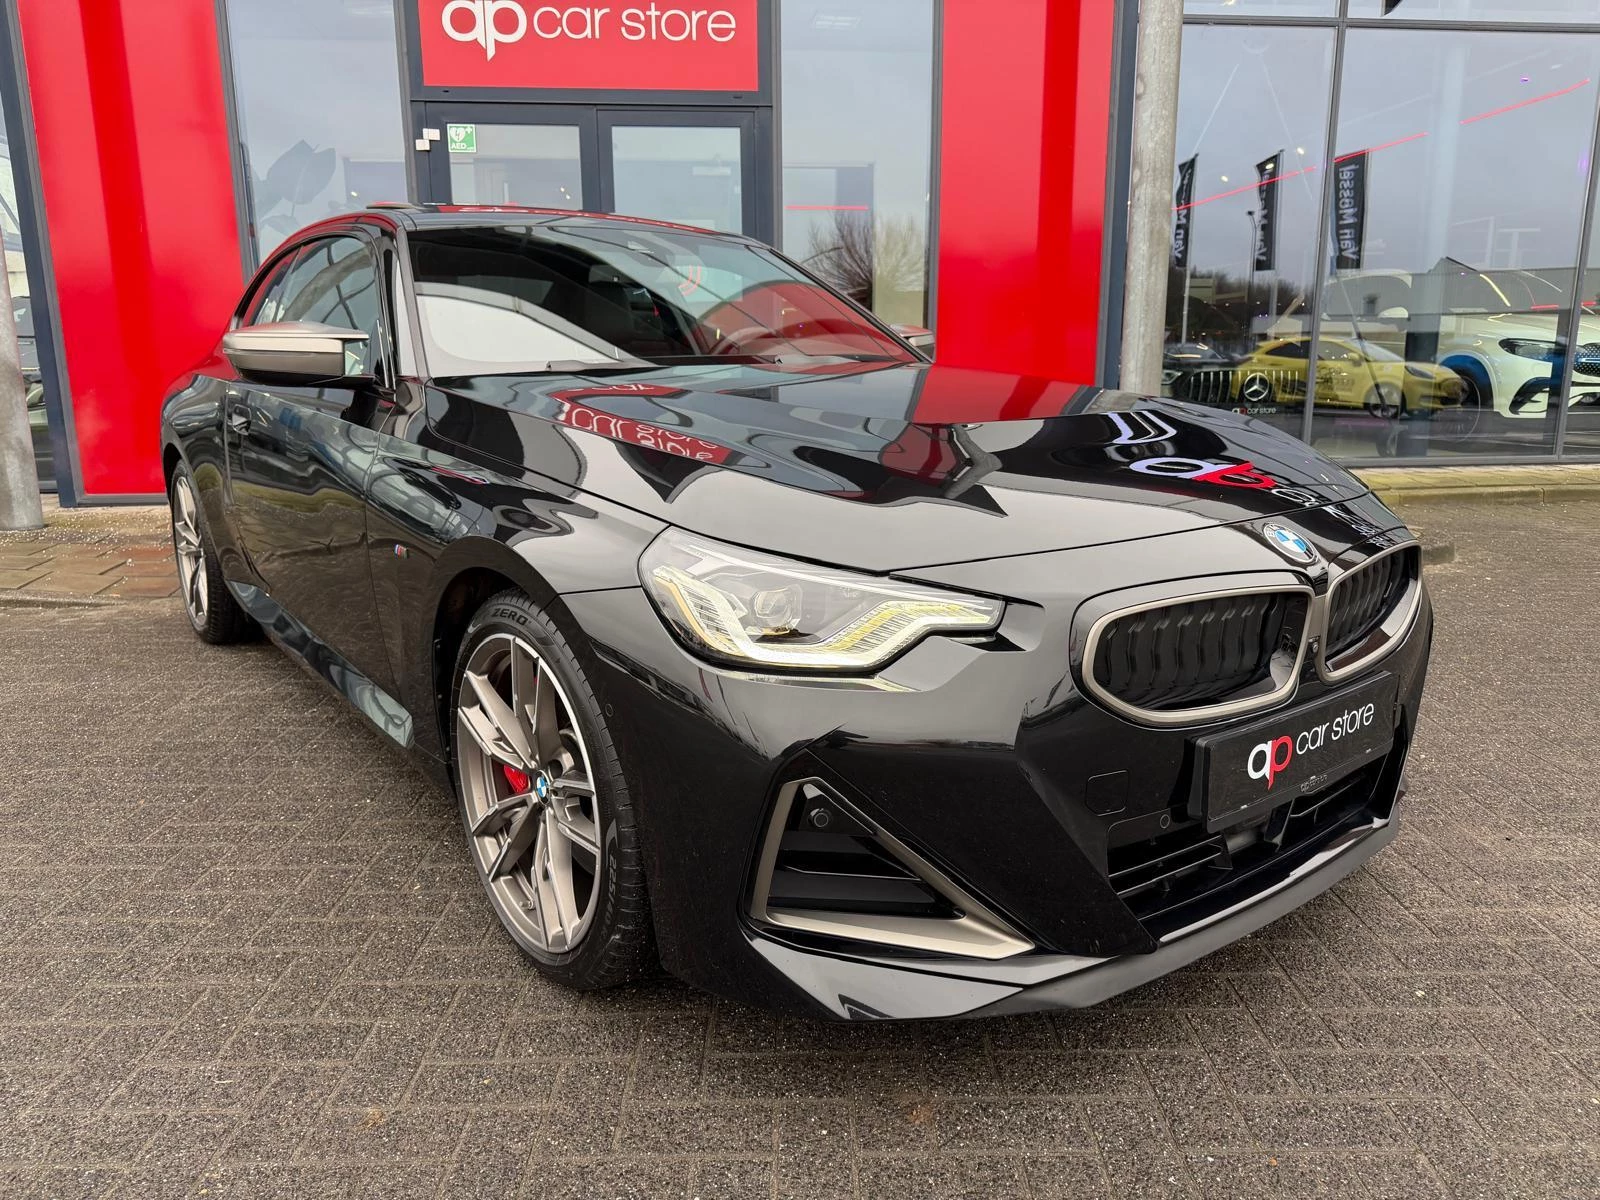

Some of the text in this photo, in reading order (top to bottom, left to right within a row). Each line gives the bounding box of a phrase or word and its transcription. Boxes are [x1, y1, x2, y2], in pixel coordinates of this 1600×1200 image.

[533, 7, 611, 39] car
[620, 2, 736, 42] store
[451, 142, 468, 150] AED
[491, 608, 529, 626] ZERO
[1296, 722, 1330, 755] car
[1331, 703, 1375, 741] store
